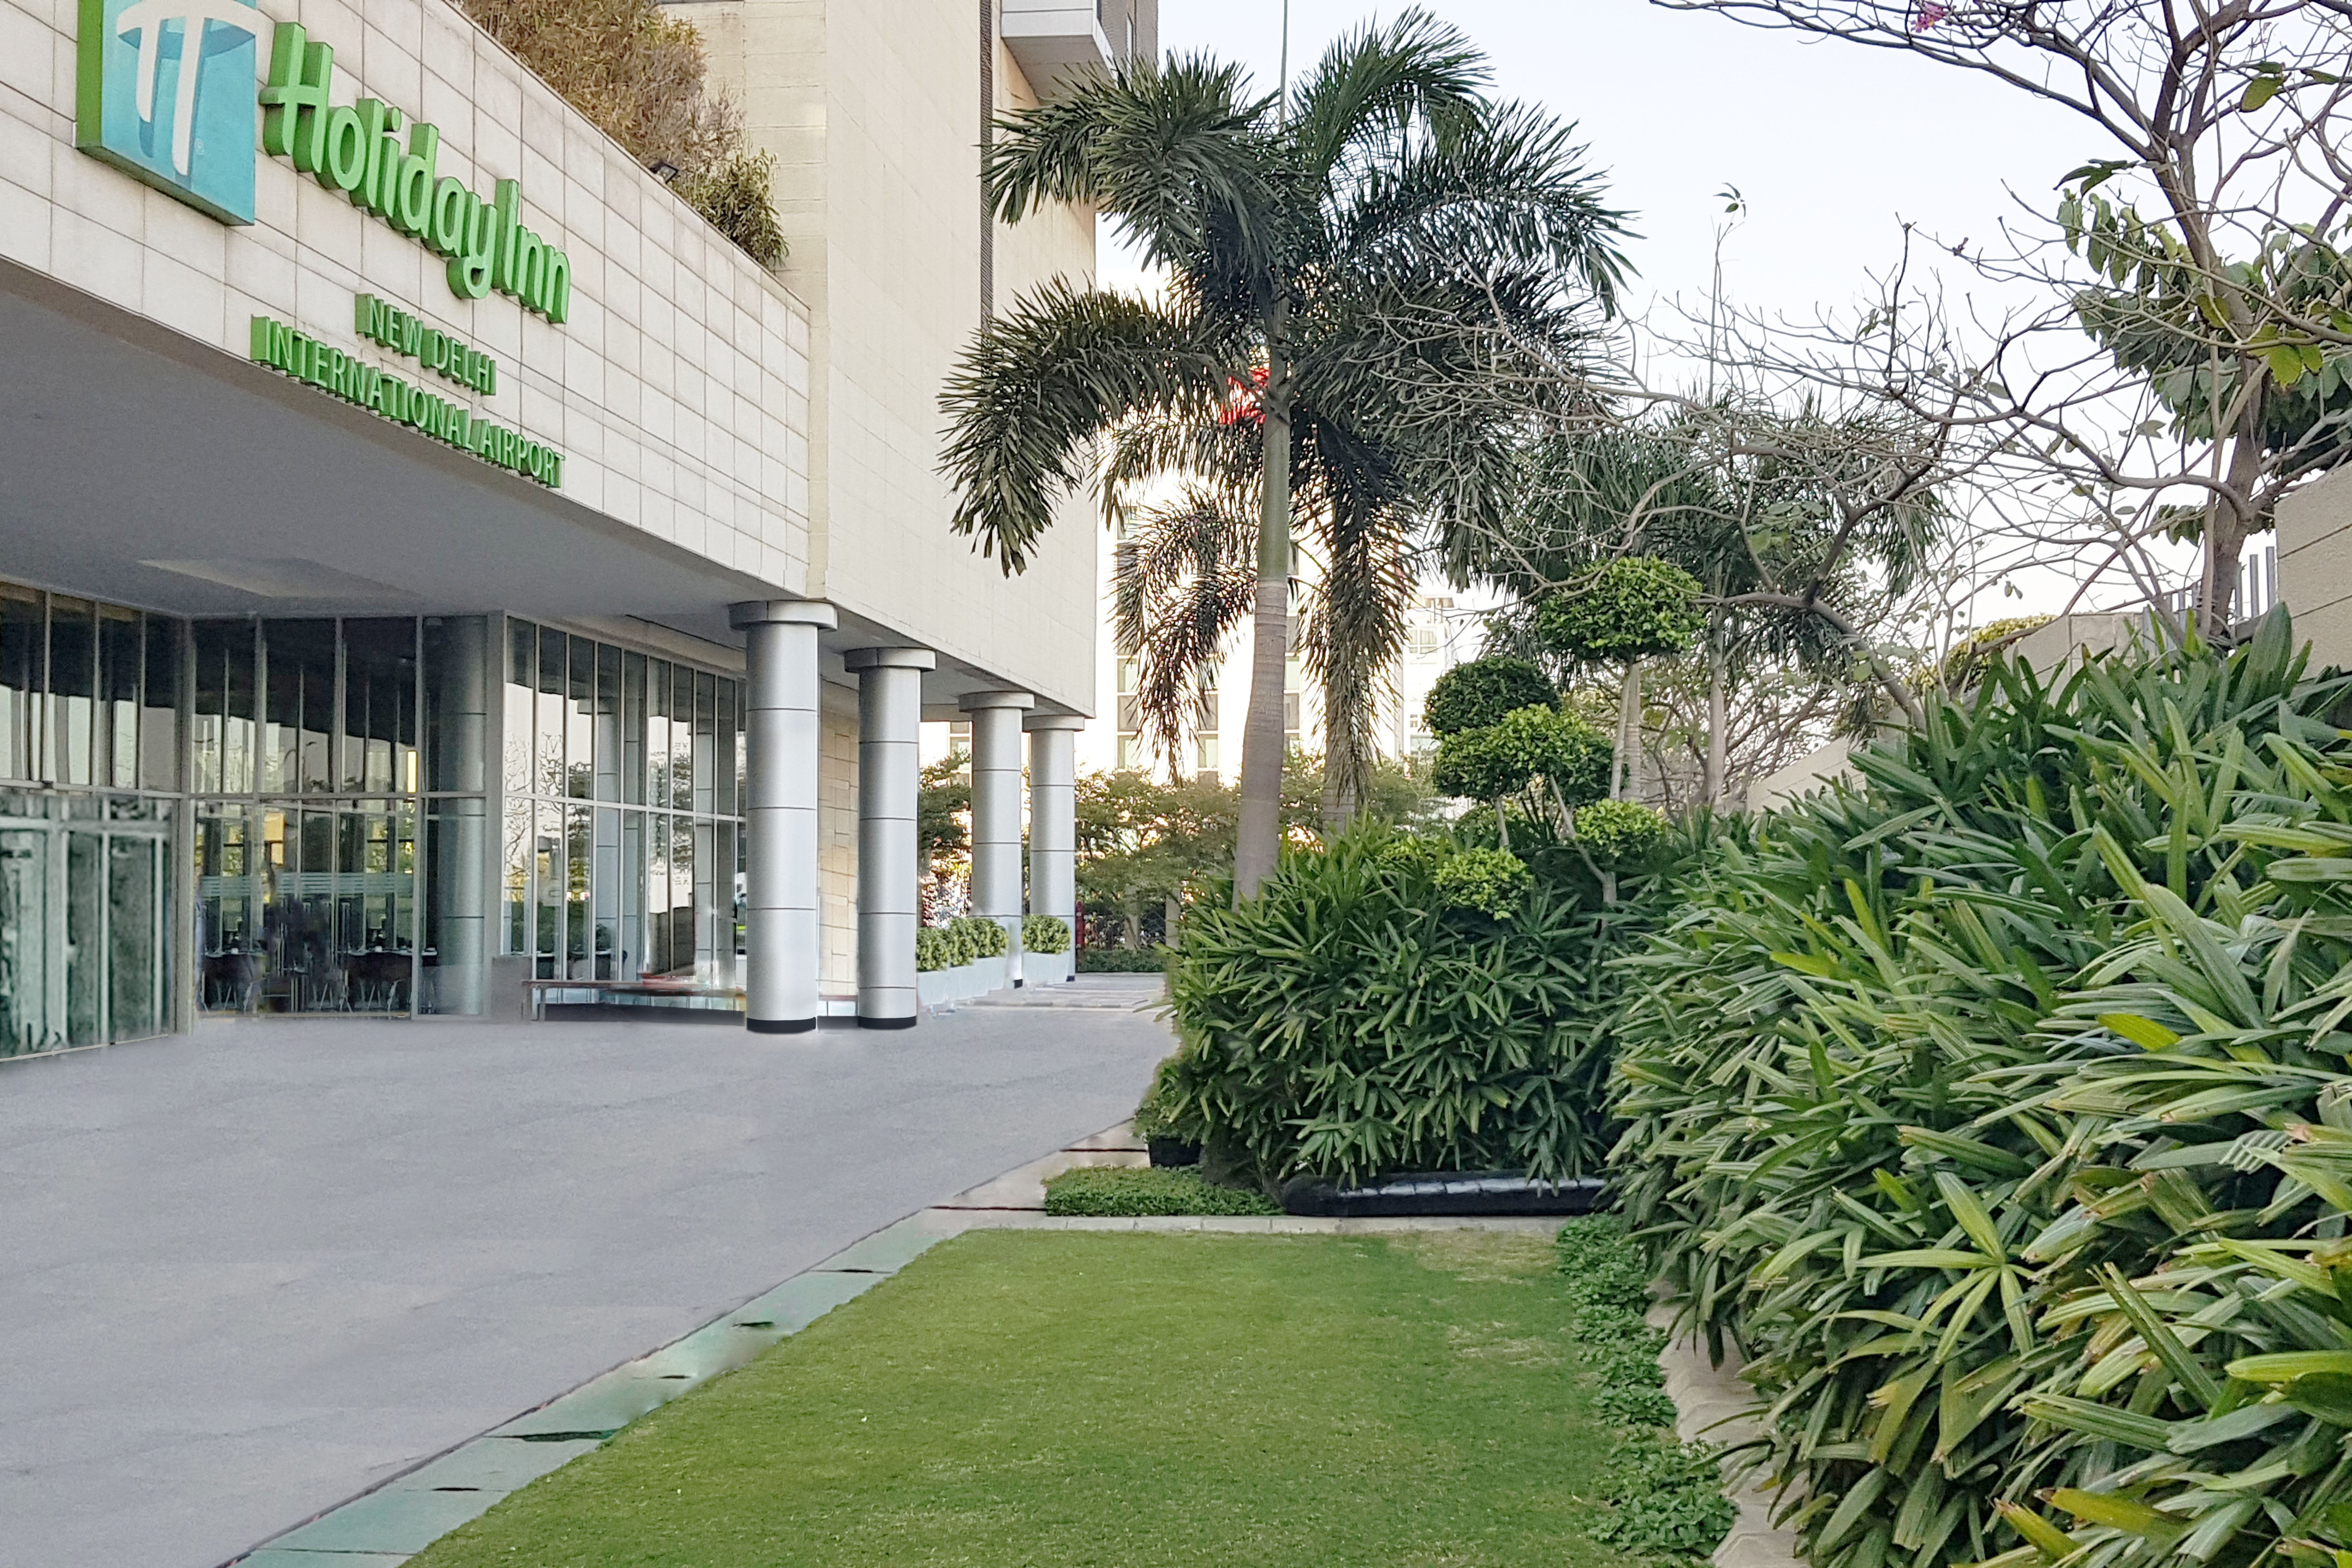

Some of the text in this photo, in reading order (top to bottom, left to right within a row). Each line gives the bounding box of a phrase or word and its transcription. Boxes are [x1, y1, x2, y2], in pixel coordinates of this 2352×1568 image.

[258, 22, 497, 299] Holiday
[495, 179, 570, 324] Inn
[252, 316, 566, 488] INTERNATIONAL AIRPORT
[357, 293, 496, 396] NEW DELHI
